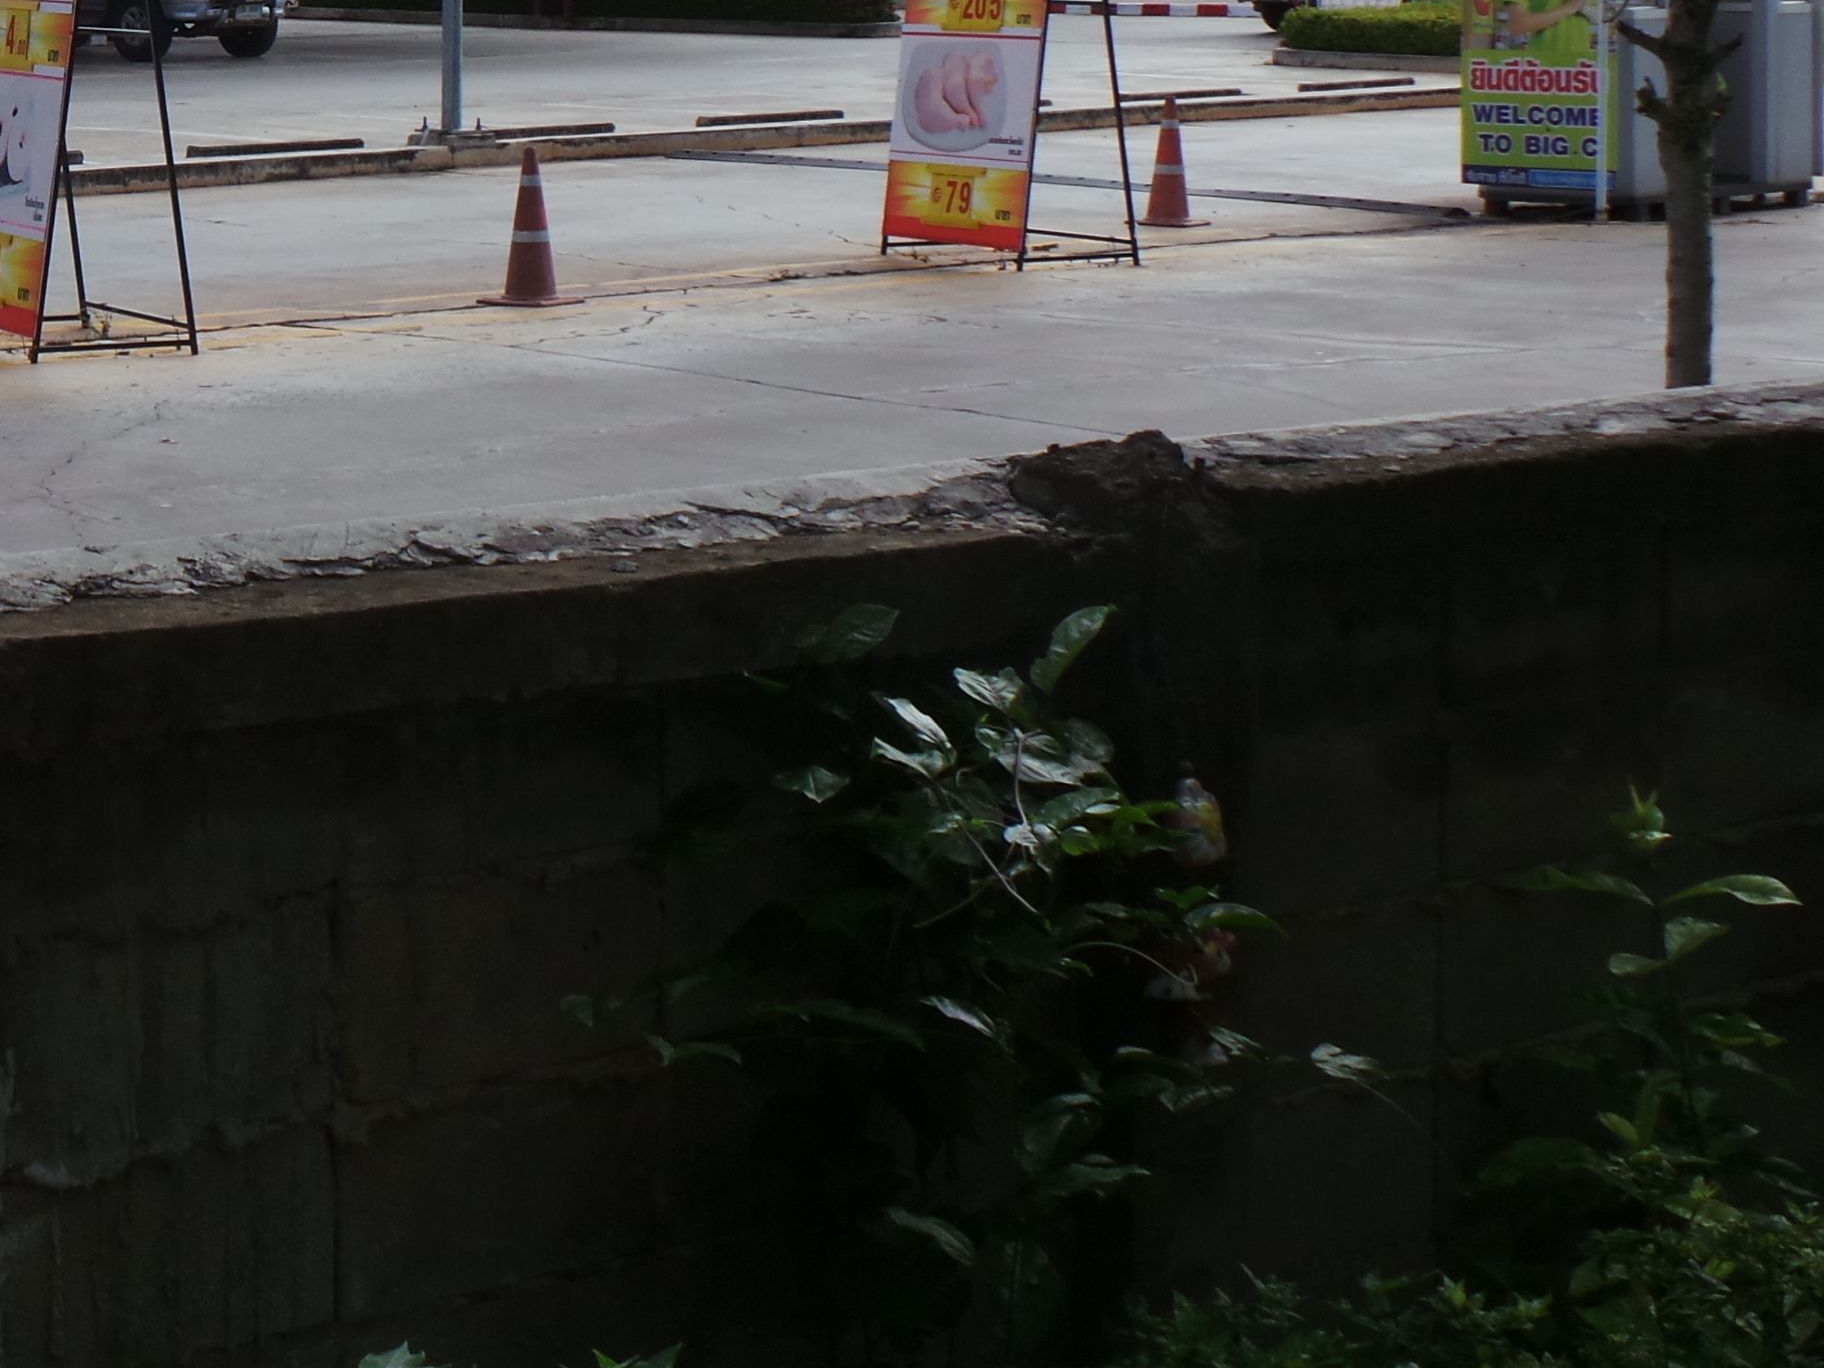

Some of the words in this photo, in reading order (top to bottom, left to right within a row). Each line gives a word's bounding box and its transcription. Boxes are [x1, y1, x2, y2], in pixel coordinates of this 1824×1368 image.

[1473, 104, 1599, 127] WELCOME
[1479, 134, 1512, 154] TO
[1525, 135, 1569, 156] BIG
[1582, 137, 1598, 157] C
[945, 180, 972, 214] 79
